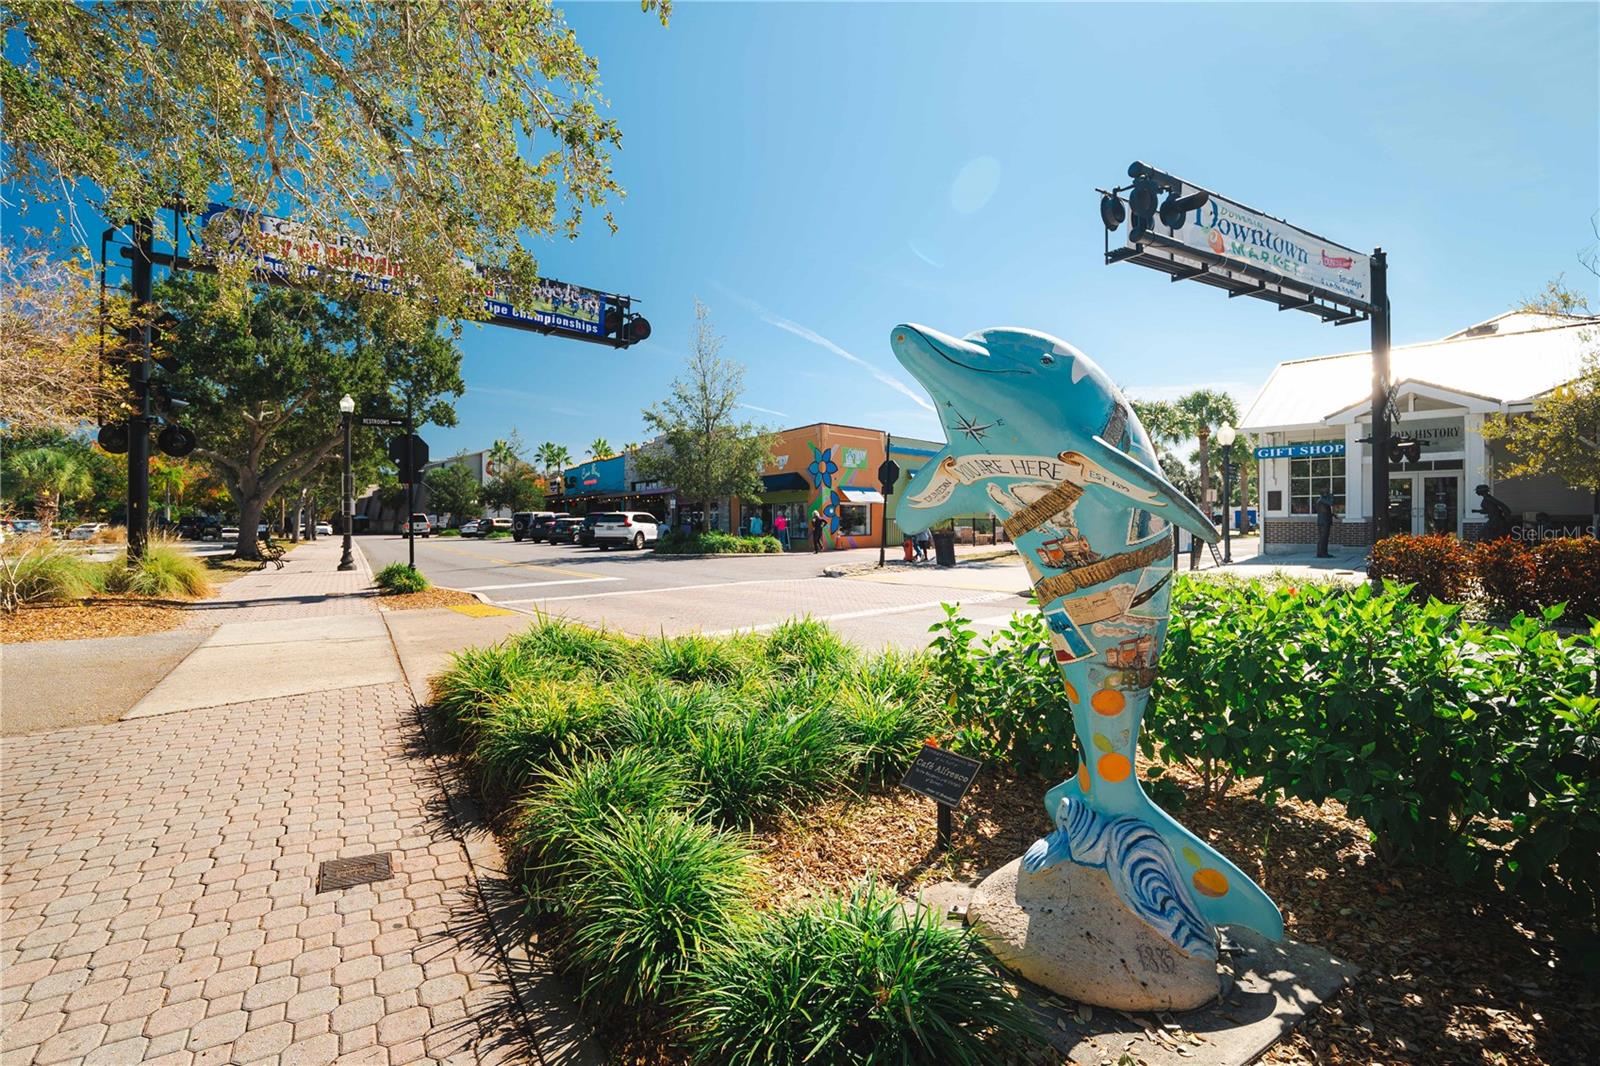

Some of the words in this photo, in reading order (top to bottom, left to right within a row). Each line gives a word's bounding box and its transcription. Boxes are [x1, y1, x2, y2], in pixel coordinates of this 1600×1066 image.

[1194, 198, 1308, 264] Downtown
[512, 306, 598, 333] Championships
[1415, 426, 1460, 439] HISTORY
[1258, 447, 1296, 457] GIFT
[1300, 444, 1344, 455] SHOP
[954, 460, 982, 481] YOU
[977, 459, 1010, 475] ARE
[1011, 459, 1065, 481] HERE
[916, 758, 935, 770] Café
[934, 766, 969, 783] Alfresco
